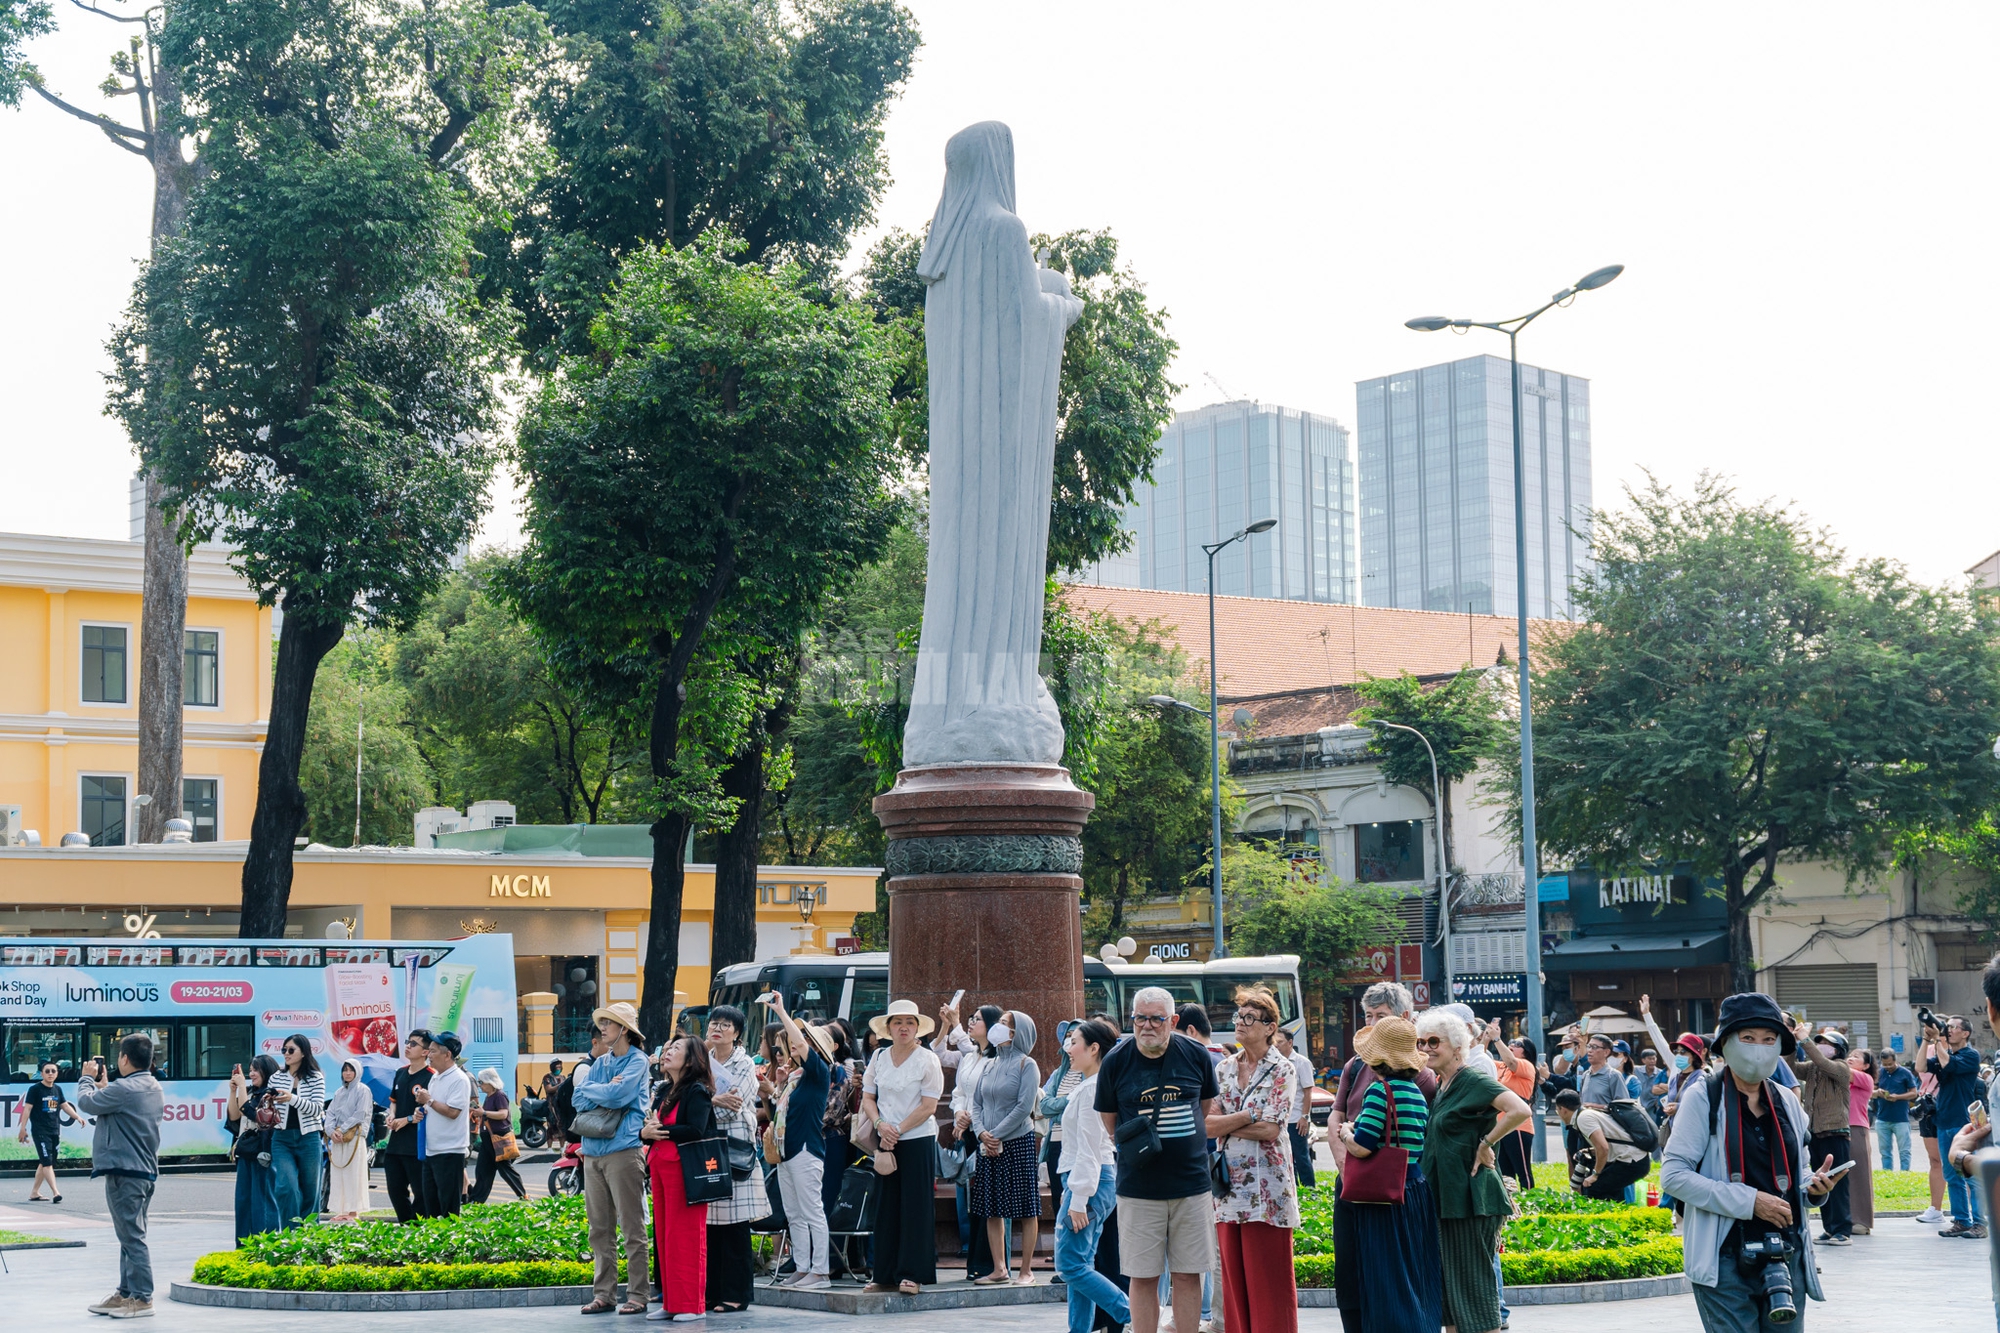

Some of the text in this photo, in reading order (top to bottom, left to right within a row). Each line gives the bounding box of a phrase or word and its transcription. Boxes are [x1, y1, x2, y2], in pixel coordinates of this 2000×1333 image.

[490, 874, 552, 897] MCM
[1600, 874, 1674, 908] KATINAT
[837, 946, 853, 955] TUMI
[11, 981, 41, 994] Shop
[66, 982, 159, 1002] luminous
[180, 986, 243, 998] 19-20-21/03
[1468, 984, 1483, 995] MY
[1483, 983, 1506, 995] BANH
[25, 995, 47, 1008] Day
[448, 973, 465, 1020] luminous
[342, 1002, 391, 1017] luminous
[1140, 1092, 1182, 1103] OXOW
